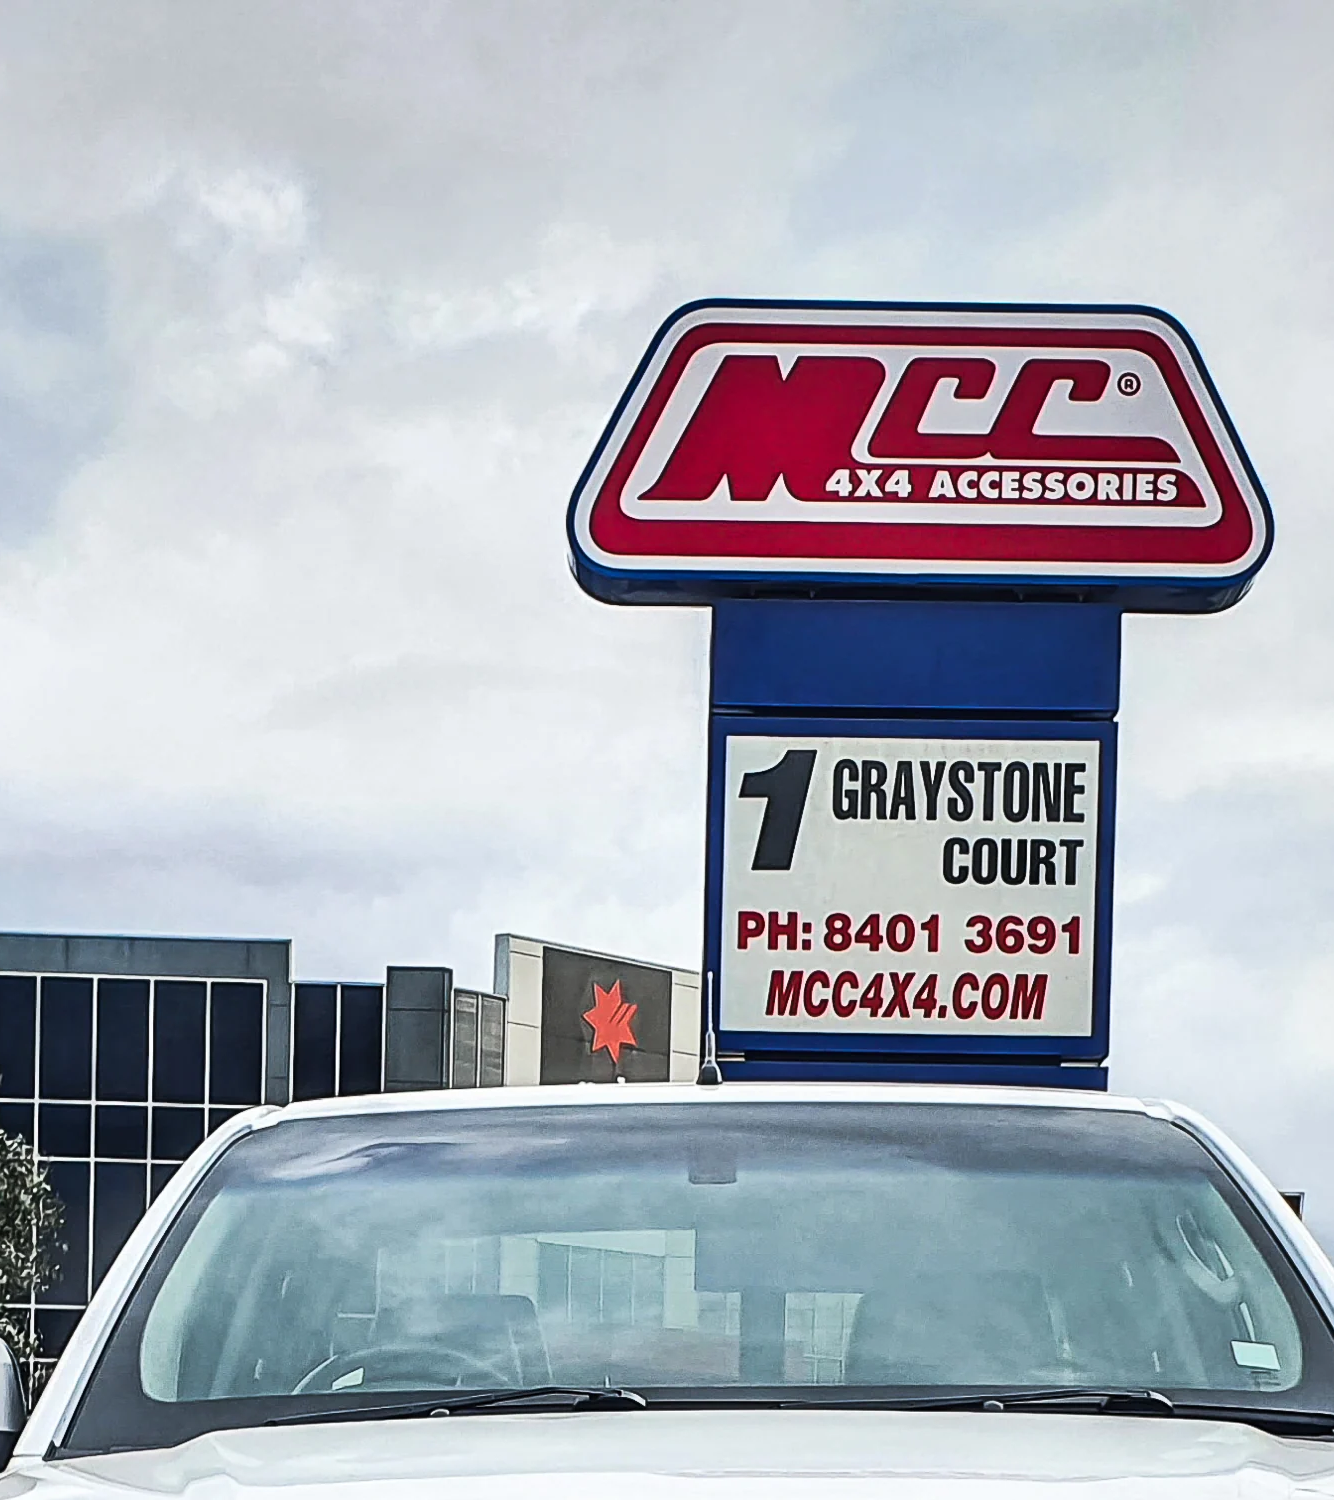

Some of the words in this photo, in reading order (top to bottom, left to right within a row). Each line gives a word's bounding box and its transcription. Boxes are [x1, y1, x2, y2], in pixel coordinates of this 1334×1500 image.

[636, 354, 1182, 501] MCC
[824, 469, 913, 498] 4X4
[928, 468, 1178, 501] ACCESSORIES
[738, 749, 818, 871] 1
[832, 758, 1087, 824] GRAYSTONE
[942, 837, 1085, 886] COURT
[737, 911, 812, 951] PH:
[823, 912, 940, 952] 8401
[964, 915, 1081, 955] 3691
[765, 969, 1049, 1020] MCC4X4.COM
